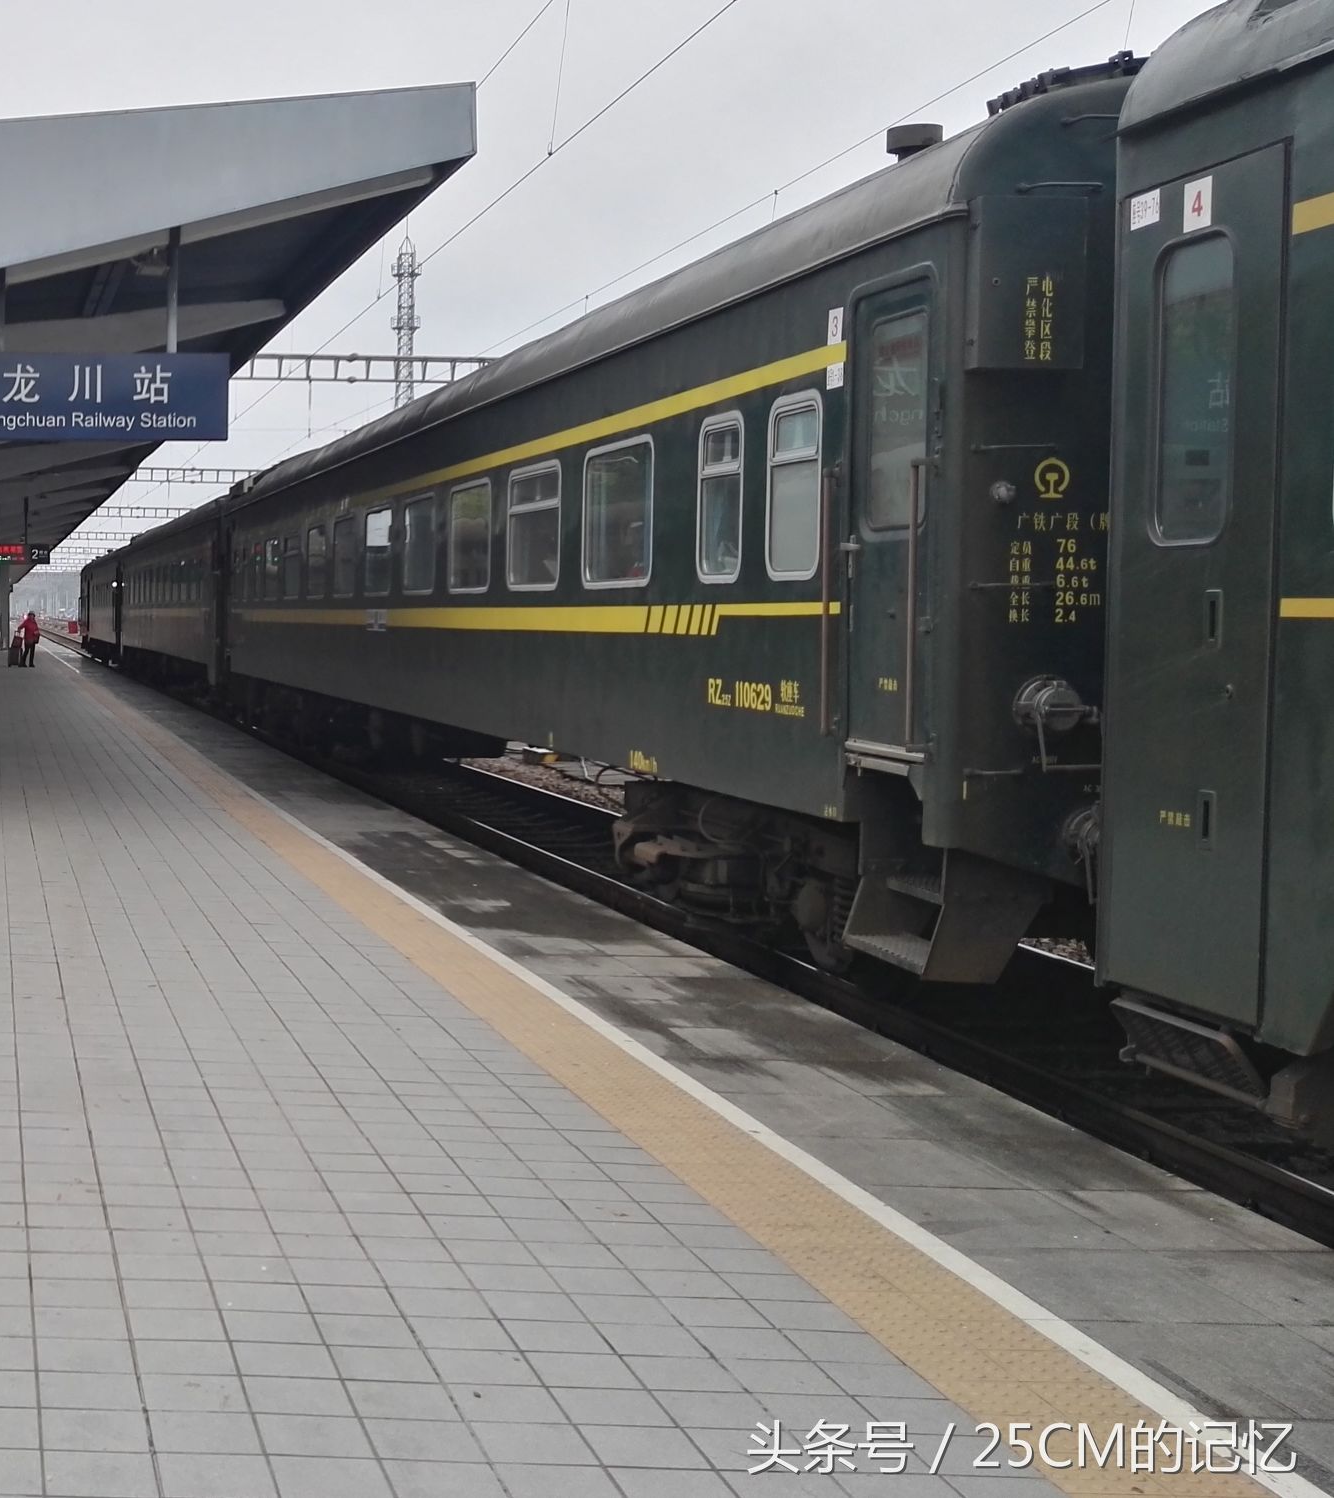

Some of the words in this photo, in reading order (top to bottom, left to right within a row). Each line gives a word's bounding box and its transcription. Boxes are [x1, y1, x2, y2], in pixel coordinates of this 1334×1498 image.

[1191, 189, 1203, 217] 4
[831, 315, 839, 337] 3
[1024, 276, 1039, 360] 严禁攀登
[1040, 275, 1054, 361] 电化区段
[1, 363, 172, 404] 龙川站
[71, 412, 135, 431] Railway
[140, 413, 197, 428] Station
[31, 549, 39, 559] 2
[1010, 541, 1032, 555] 定员
[1056, 539, 1077, 553] 76
[1009, 558, 1031, 572] 自重
[1055, 557, 1097, 571] 44.6t
[1009, 591, 1030, 606] 全长
[1055, 591, 1100, 606] 26.6m
[1054, 608, 1077, 623] 2.4
[735, 680, 772, 711] 110629
